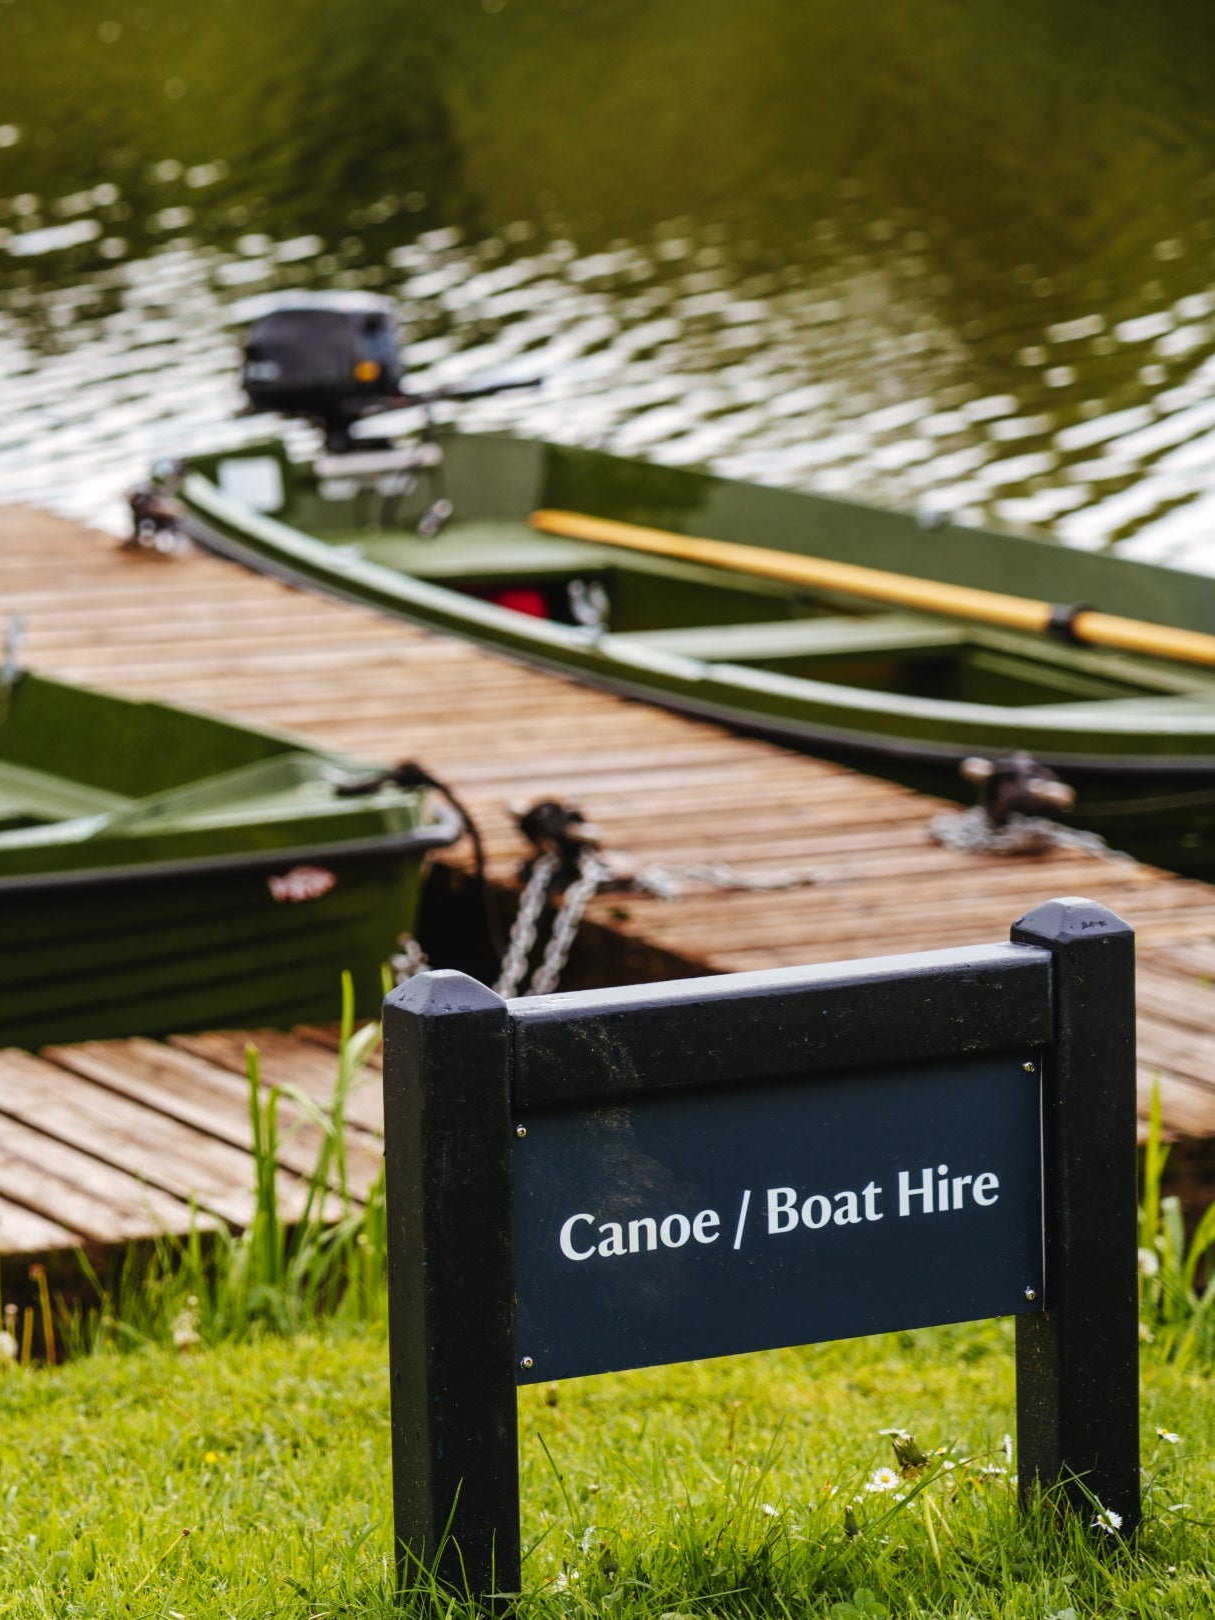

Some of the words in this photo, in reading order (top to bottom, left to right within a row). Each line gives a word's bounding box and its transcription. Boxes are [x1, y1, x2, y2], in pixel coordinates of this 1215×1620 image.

[559, 1208, 721, 1261] Canoe
[733, 1189, 752, 1250] /
[766, 1180, 884, 1235] Boat
[898, 1164, 1000, 1217] Hire
